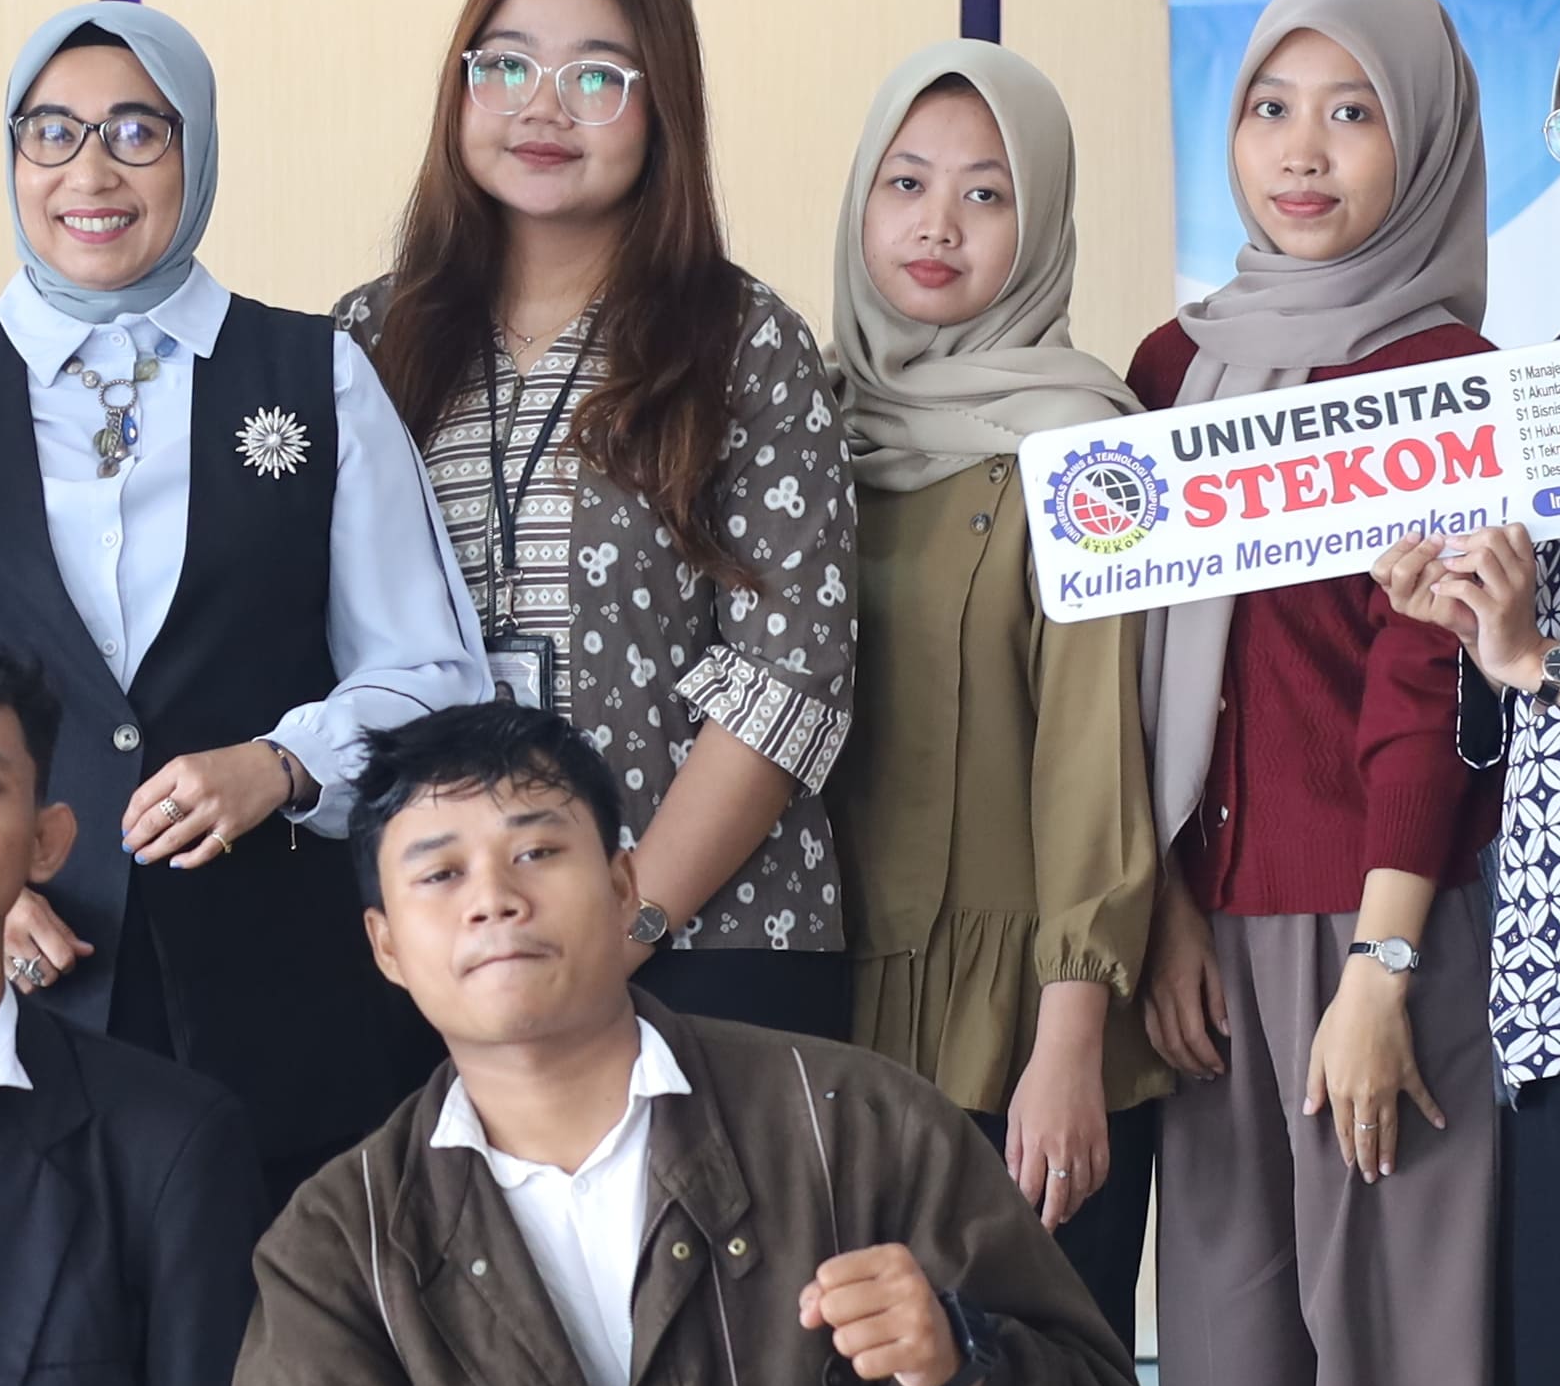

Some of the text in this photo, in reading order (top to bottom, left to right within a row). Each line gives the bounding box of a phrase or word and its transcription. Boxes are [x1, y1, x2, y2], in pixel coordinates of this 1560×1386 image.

[1170, 375, 1493, 462] UNIVERSITAS
[1095, 452, 1149, 480] TEKNOLOGI
[1181, 424, 1504, 528] STEKOM
[1060, 556, 1224, 602] Kuliahnya
